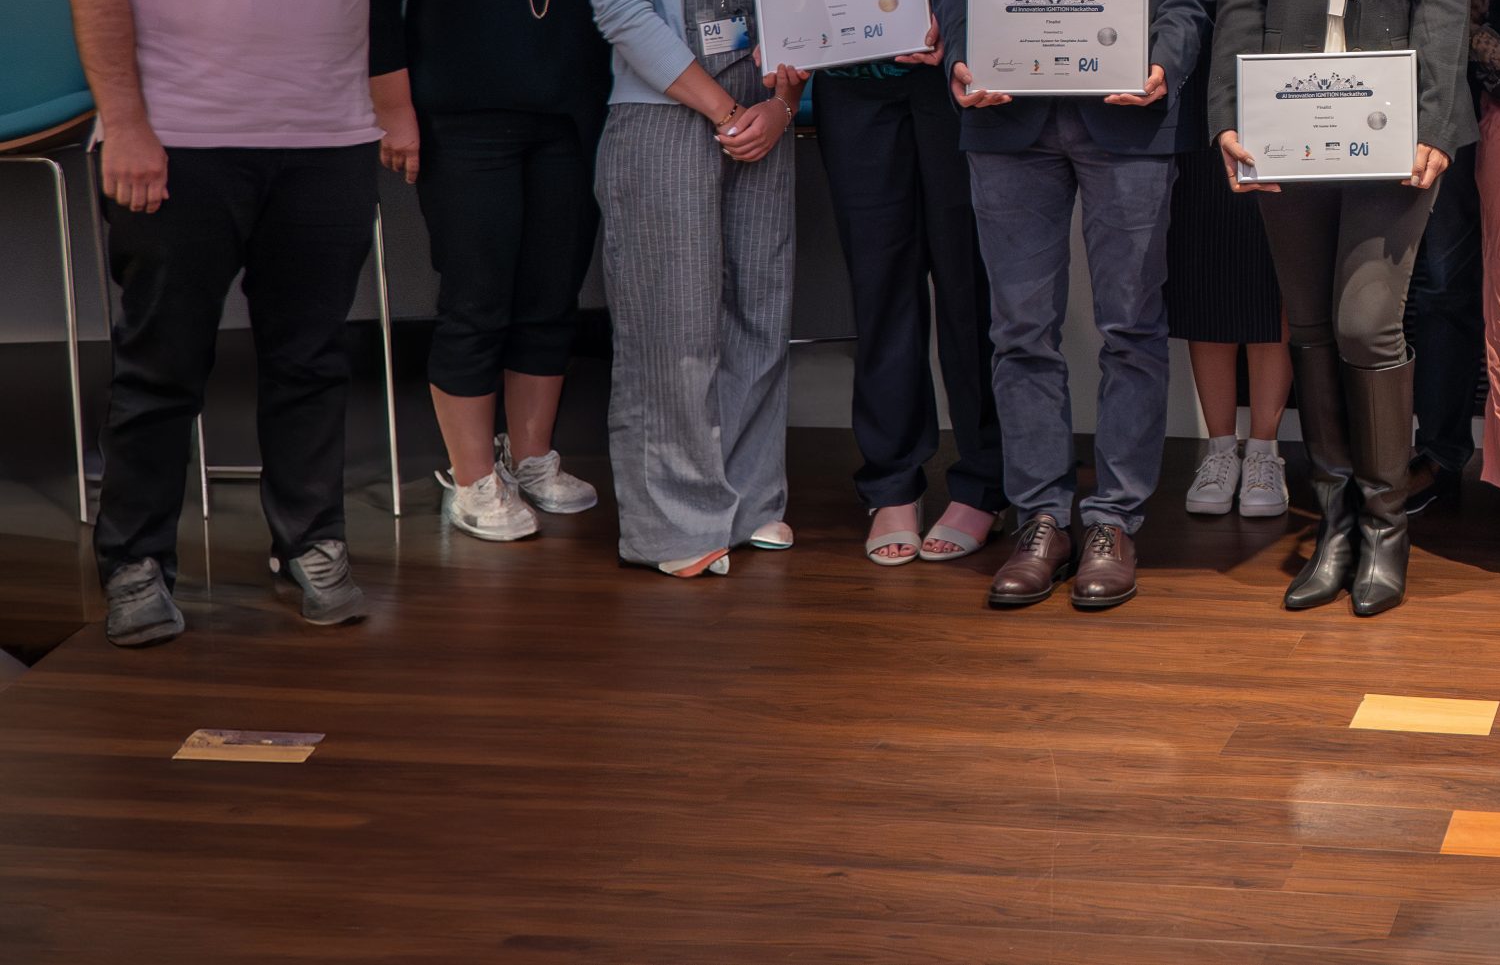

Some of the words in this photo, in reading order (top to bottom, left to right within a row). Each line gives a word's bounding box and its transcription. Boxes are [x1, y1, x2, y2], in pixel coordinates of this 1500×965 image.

[864, 23, 883, 39] RAi
[1078, 58, 1098, 72] RAi
[1350, 141, 1369, 157] RAi
